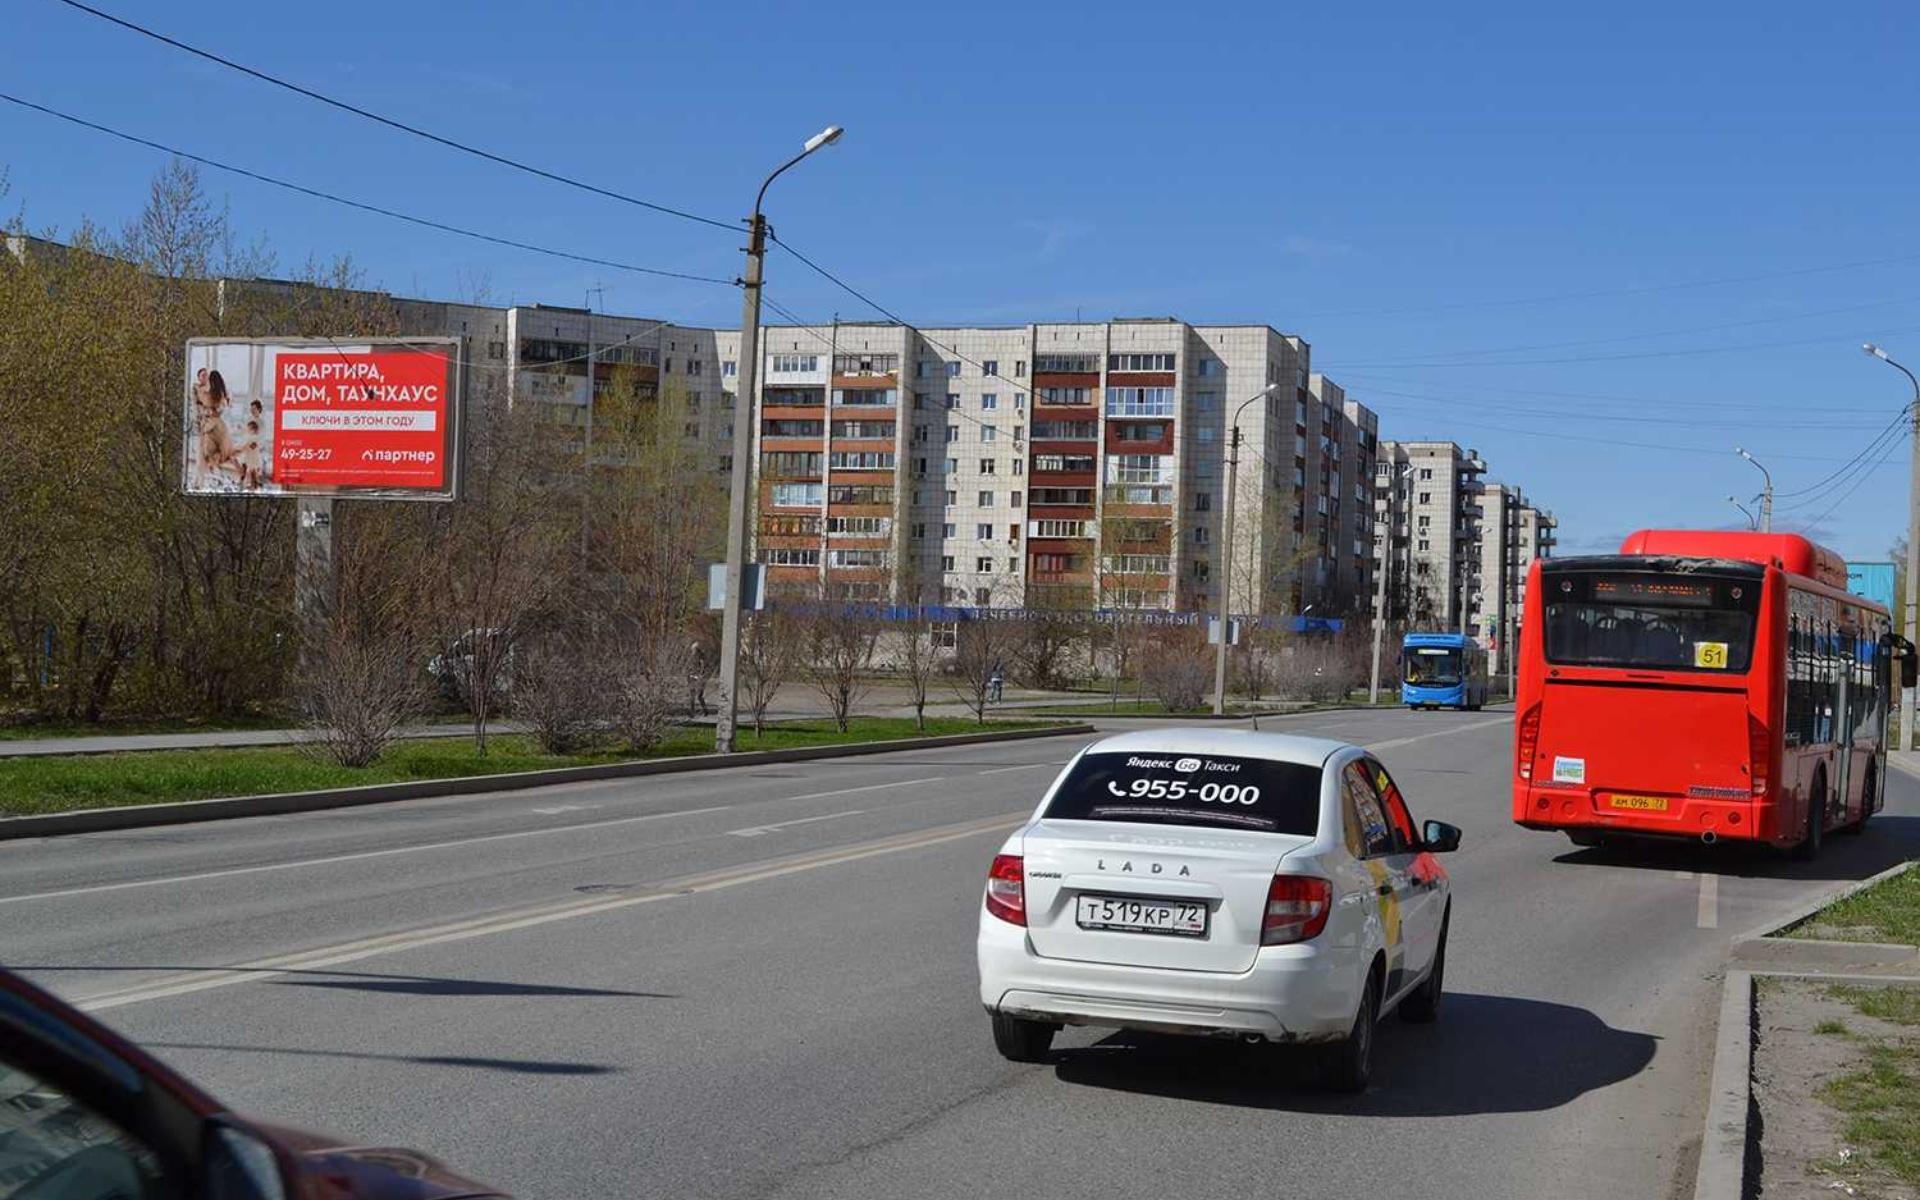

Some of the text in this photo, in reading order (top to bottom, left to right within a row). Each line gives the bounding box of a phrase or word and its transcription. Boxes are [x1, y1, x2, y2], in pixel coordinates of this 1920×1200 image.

[283, 363, 385, 383] КВАРТИРА,
[282, 384, 438, 406] ДОМ, ТАУНХАУС
[301, 415, 415, 427] КЛЮЧИ В ЭТОМ ГОДУ
[280, 448, 435, 464] 49-25-27 партнер
[1703, 649, 1721, 664] 51
[1126, 756, 1173, 769] Яндекс
[1203, 761, 1241, 772] Такси
[1129, 778, 1260, 805] 955-000
[1097, 859, 1190, 877] LADA
[1087, 900, 1198, 925] Т519КР 72
